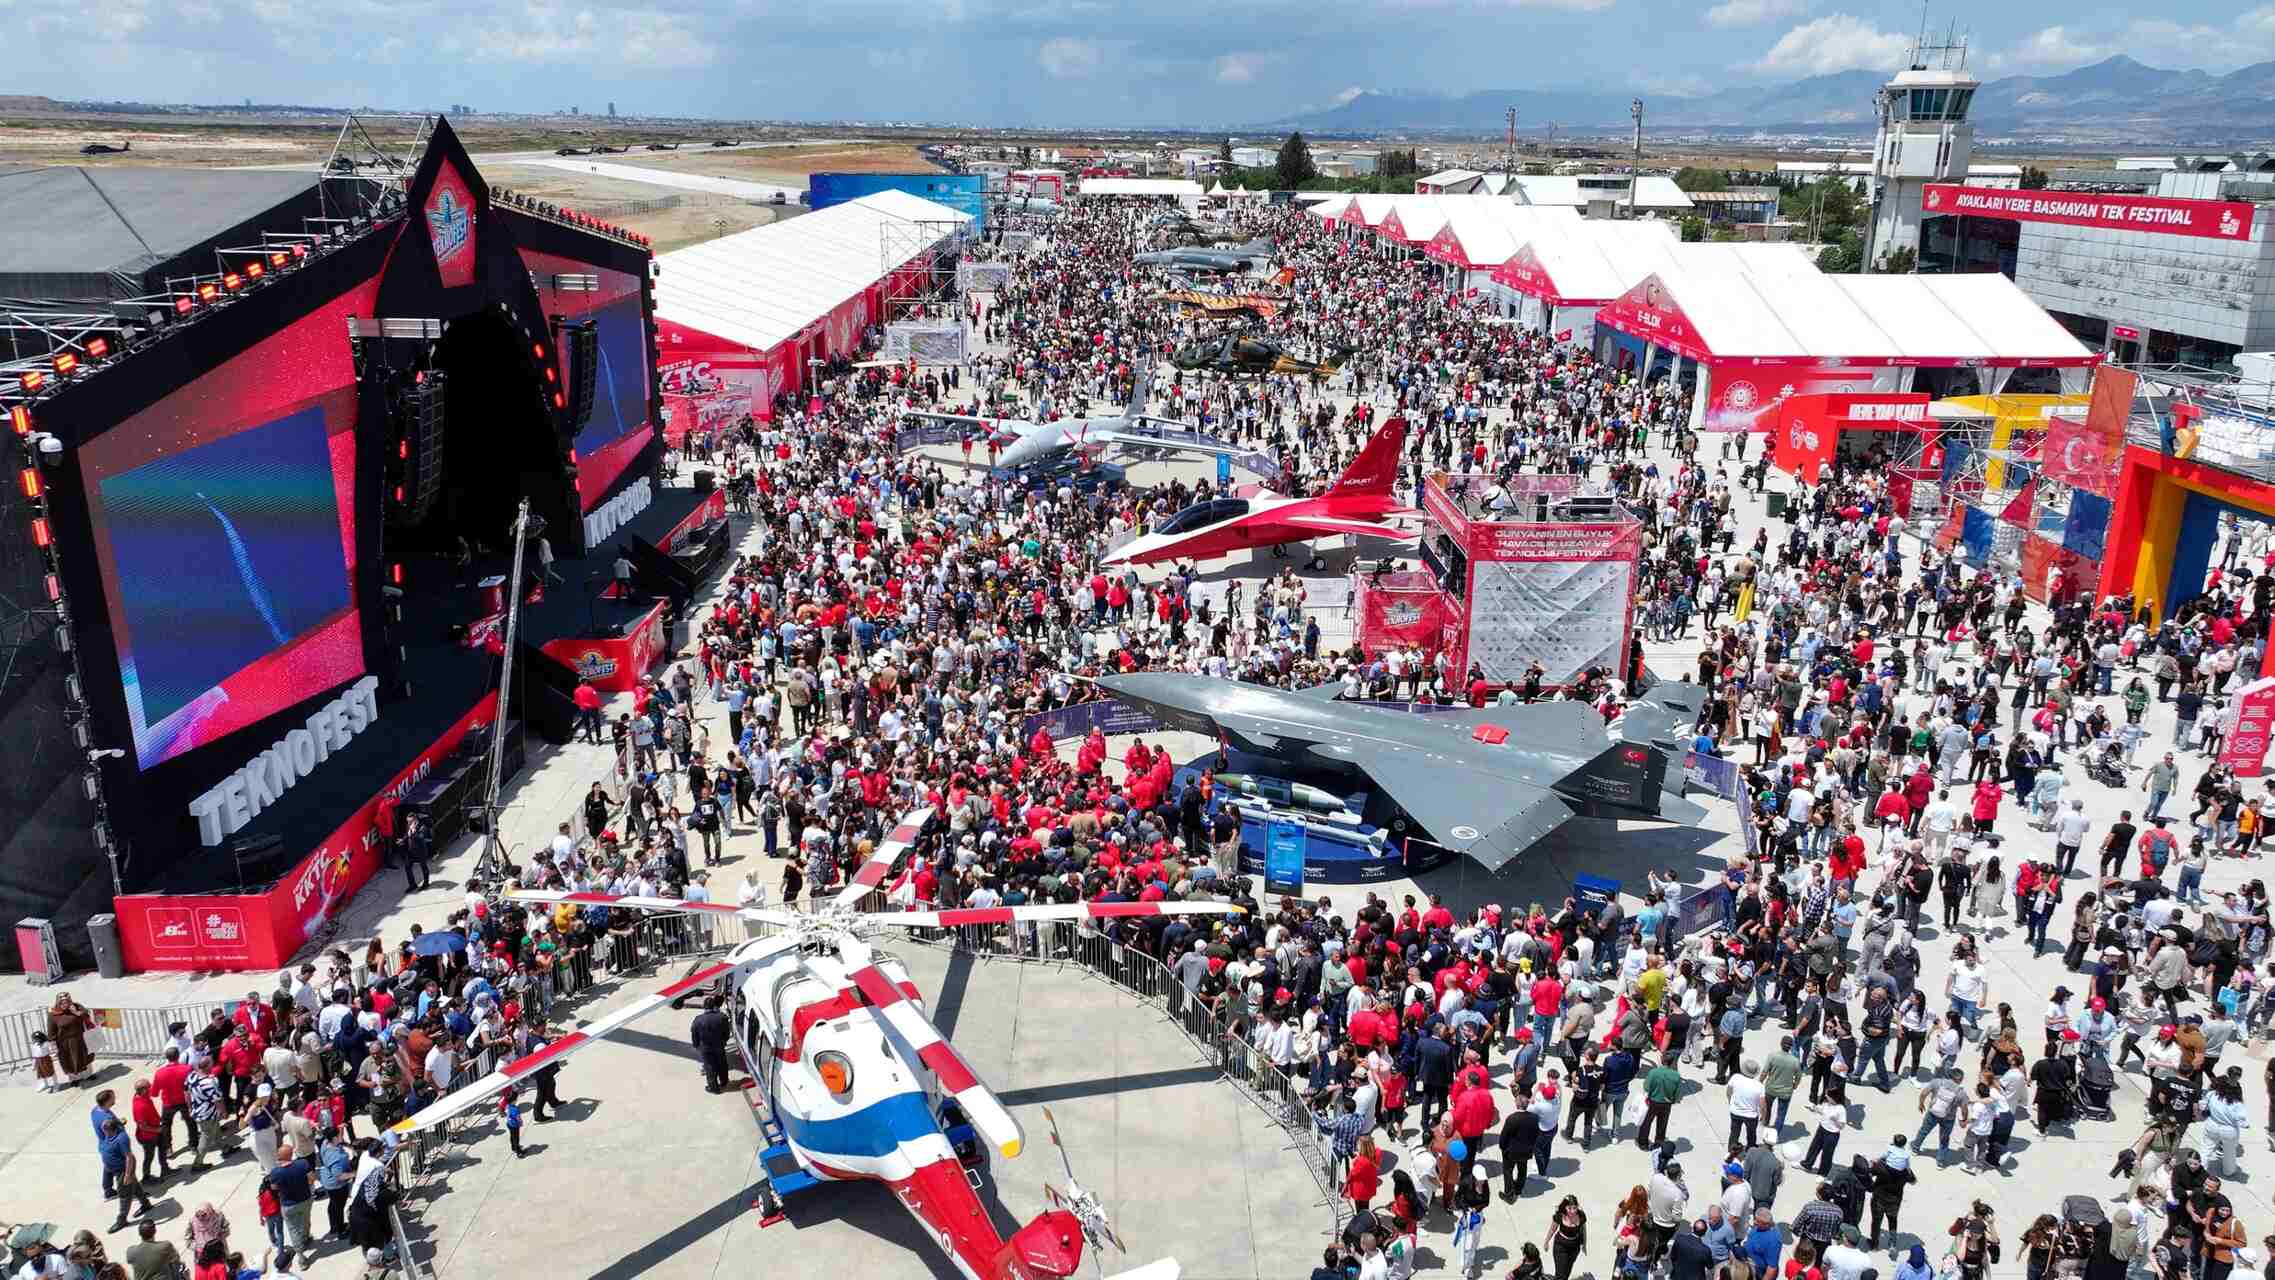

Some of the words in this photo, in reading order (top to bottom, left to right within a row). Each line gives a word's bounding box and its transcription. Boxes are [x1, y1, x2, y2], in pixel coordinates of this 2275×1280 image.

[1956, 193, 2003, 211] AYAKLARI
[2004, 198, 2031, 212] YERE
[2033, 199, 2098, 218] BASMAYAN
[2101, 204, 2125, 220] TEK
[188, 675, 379, 847] TEKNOFEST
